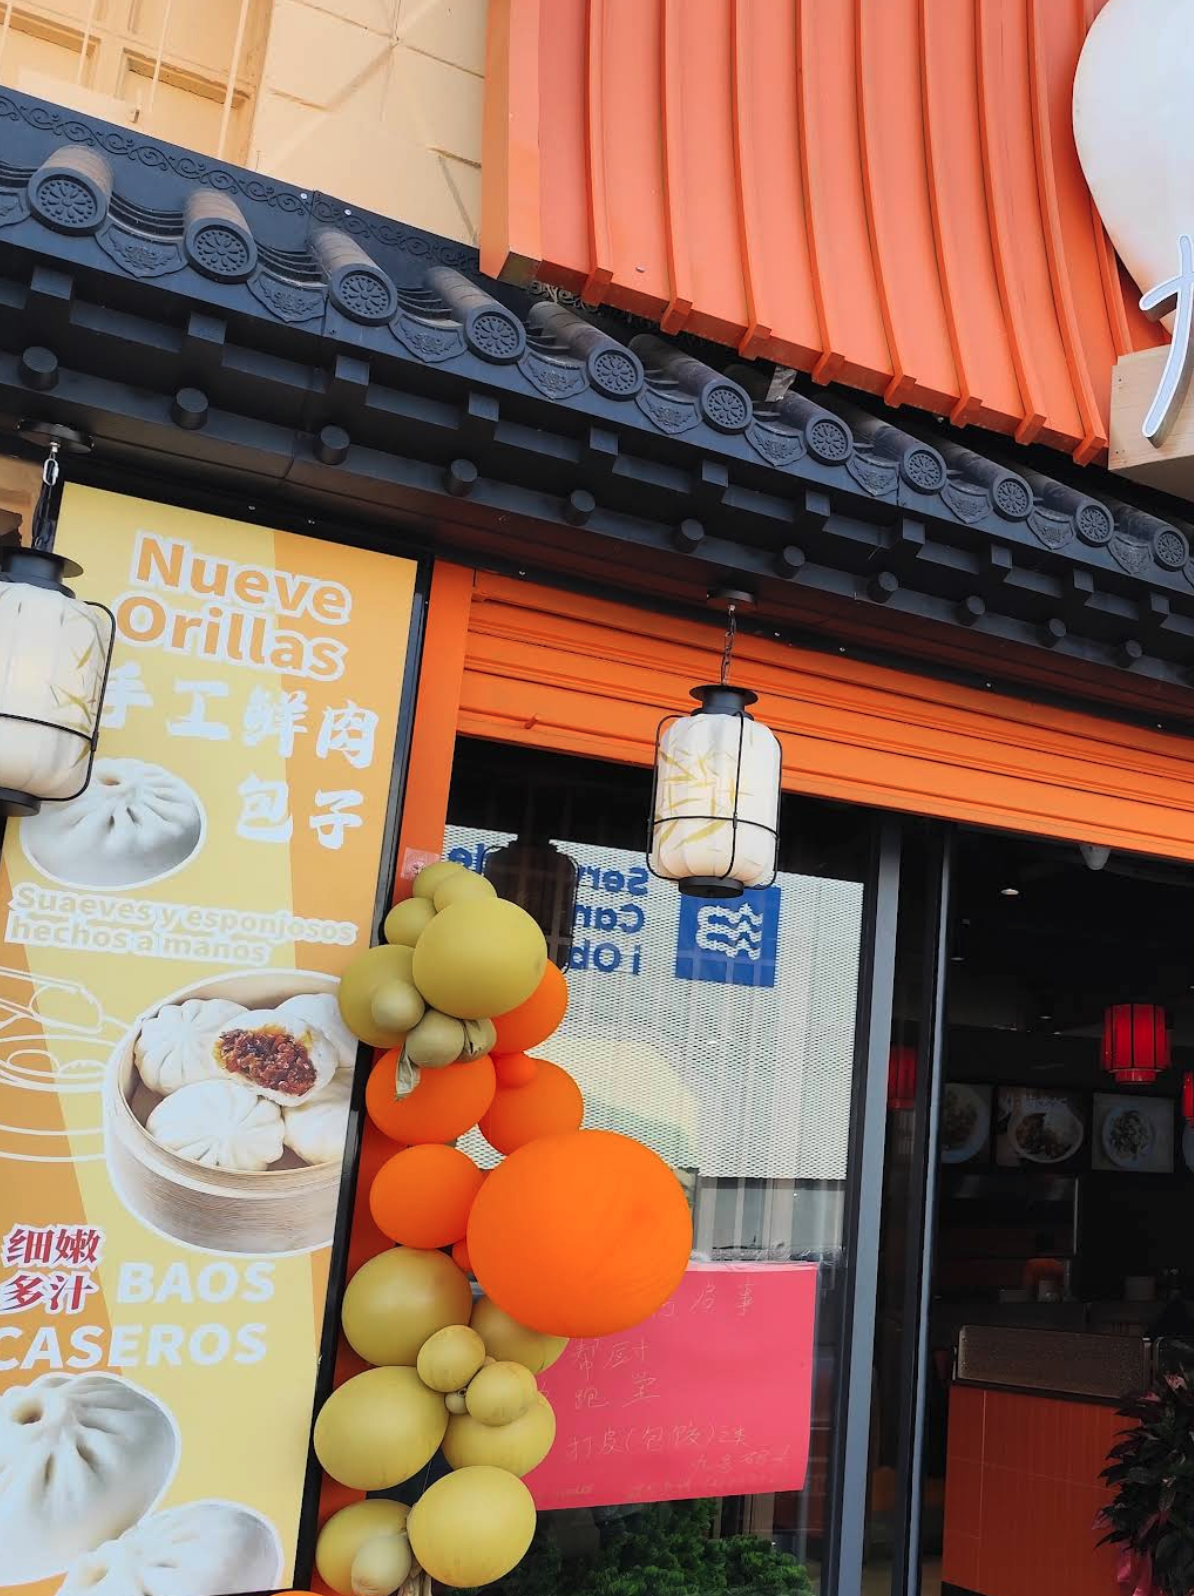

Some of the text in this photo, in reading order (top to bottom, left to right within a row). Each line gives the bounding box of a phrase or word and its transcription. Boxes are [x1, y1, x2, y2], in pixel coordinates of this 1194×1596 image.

[134, 534, 349, 622] Nueve
[115, 594, 341, 677] Orillas
[101, 662, 379, 768] 手工鲜肉
[237, 772, 364, 849] 包子
[10, 915, 266, 964] hechos a manos
[17, 891, 353, 941] Suaeves y esponjosos
[7, 1228, 101, 1264] 细嫩
[0, 1275, 93, 1311] 多汁
[117, 1261, 275, 1304] BAOS
[0, 1322, 267, 1371] CASEROS
